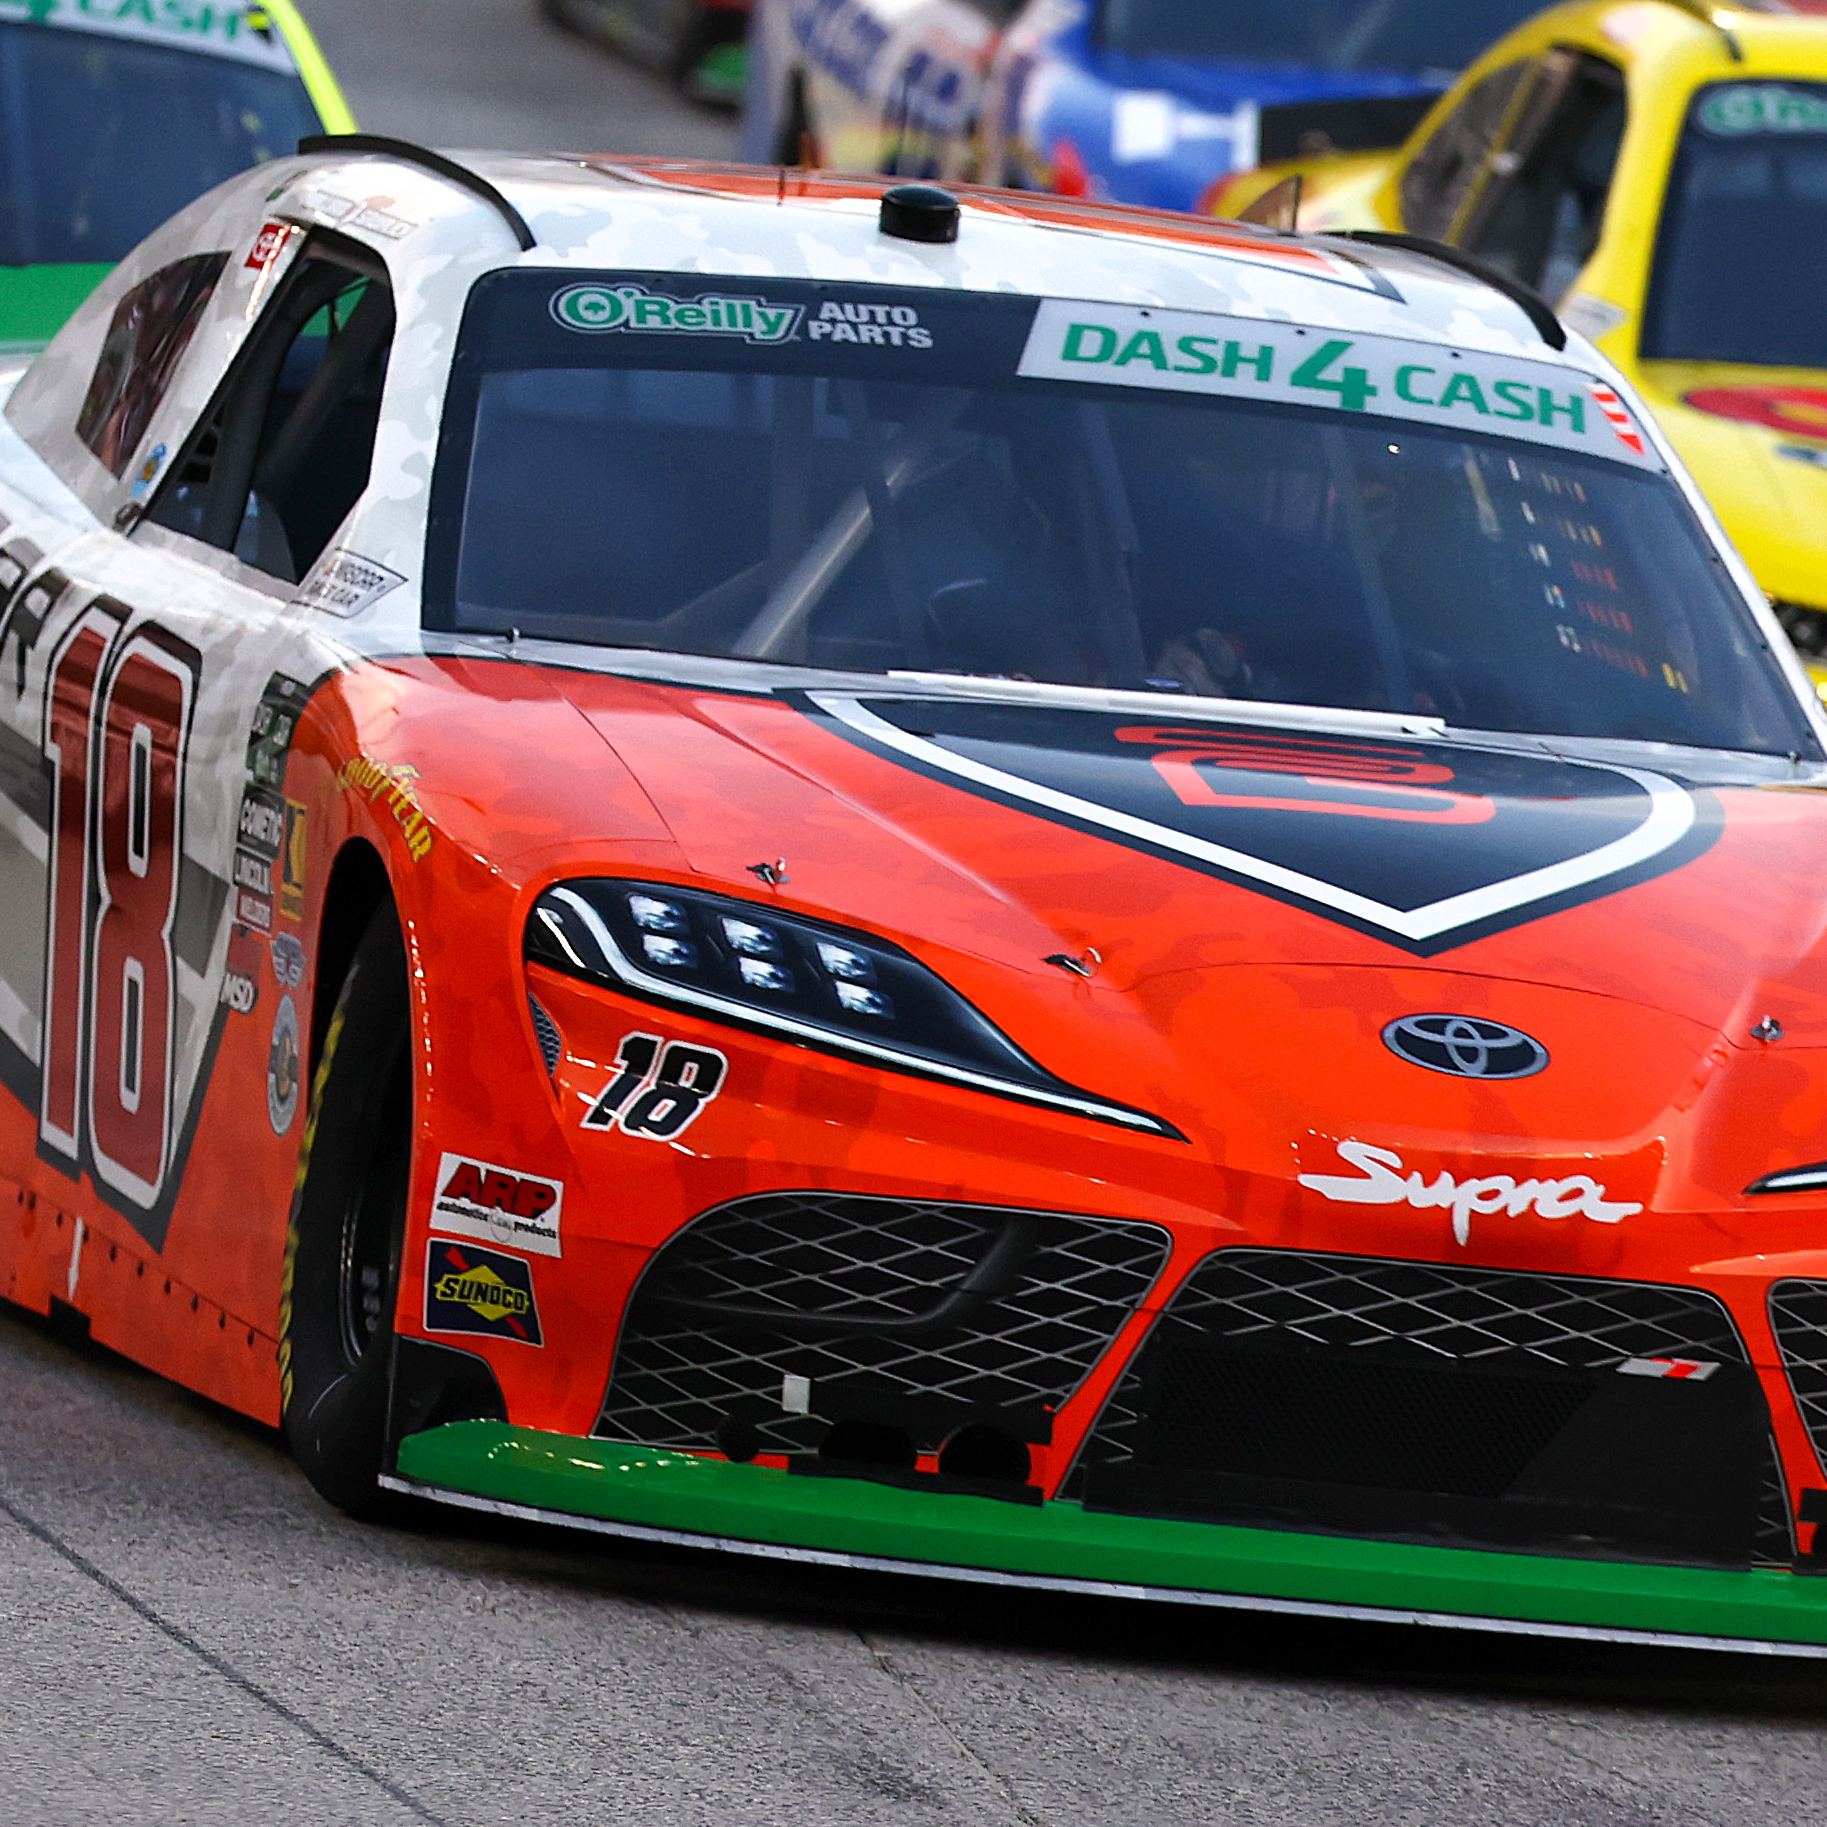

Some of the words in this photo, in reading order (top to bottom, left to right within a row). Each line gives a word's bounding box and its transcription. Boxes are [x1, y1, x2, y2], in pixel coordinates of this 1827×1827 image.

[556, 284, 797, 340] O'Reilly
[807, 319, 934, 349] PARTS
[818, 301, 918, 328] AUTO
[1061, 323, 1273, 382] DASH
[1289, 340, 1378, 412] 4
[1394, 364, 1586, 434] CASH
[34, 592, 204, 1212] 18
[579, 1030, 729, 1142] 18
[441, 1161, 558, 1220] ARP
[1296, 1140, 1644, 1246] Supra
[439, 1276, 529, 1312] SUNOCO
